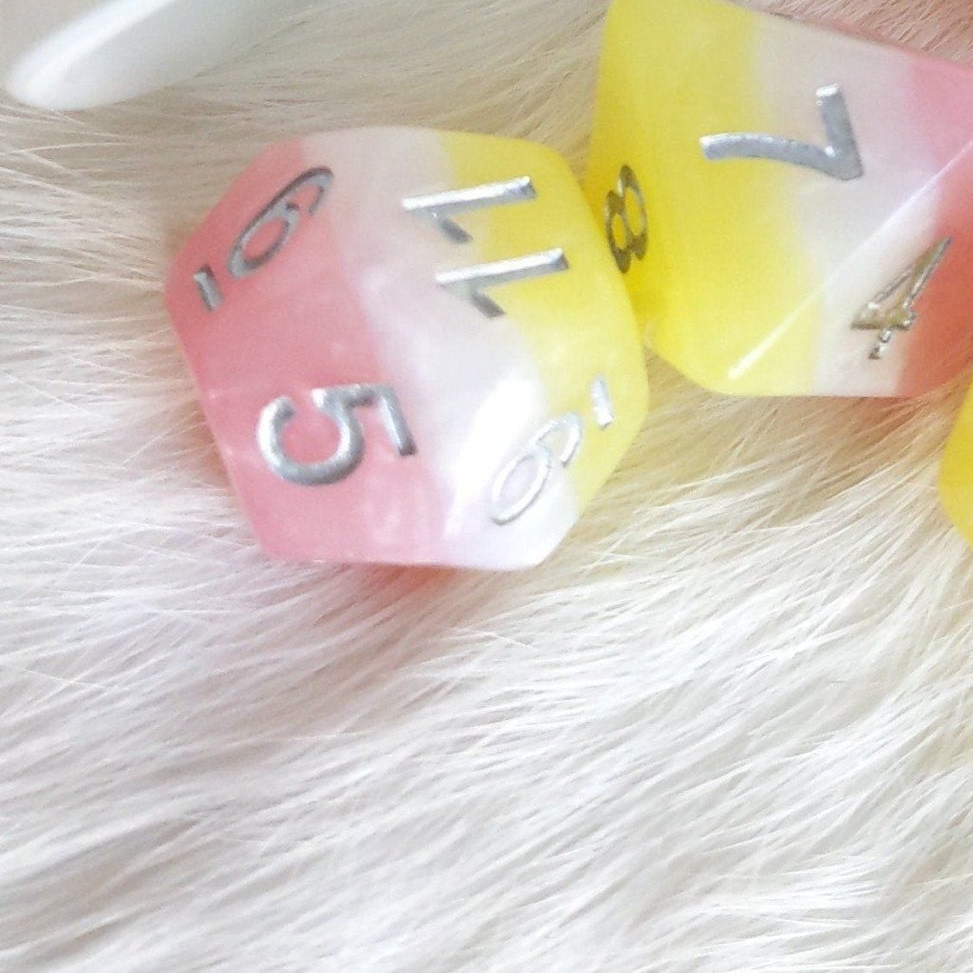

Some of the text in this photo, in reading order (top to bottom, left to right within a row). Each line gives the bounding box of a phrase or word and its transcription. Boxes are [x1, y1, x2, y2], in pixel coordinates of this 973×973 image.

[699, 83, 863, 182] 7
[401, 175, 571, 319] 11
[604, 165, 649, 275] 8
[851, 236, 952, 360] 4
[257, 383, 418, 486] 5
